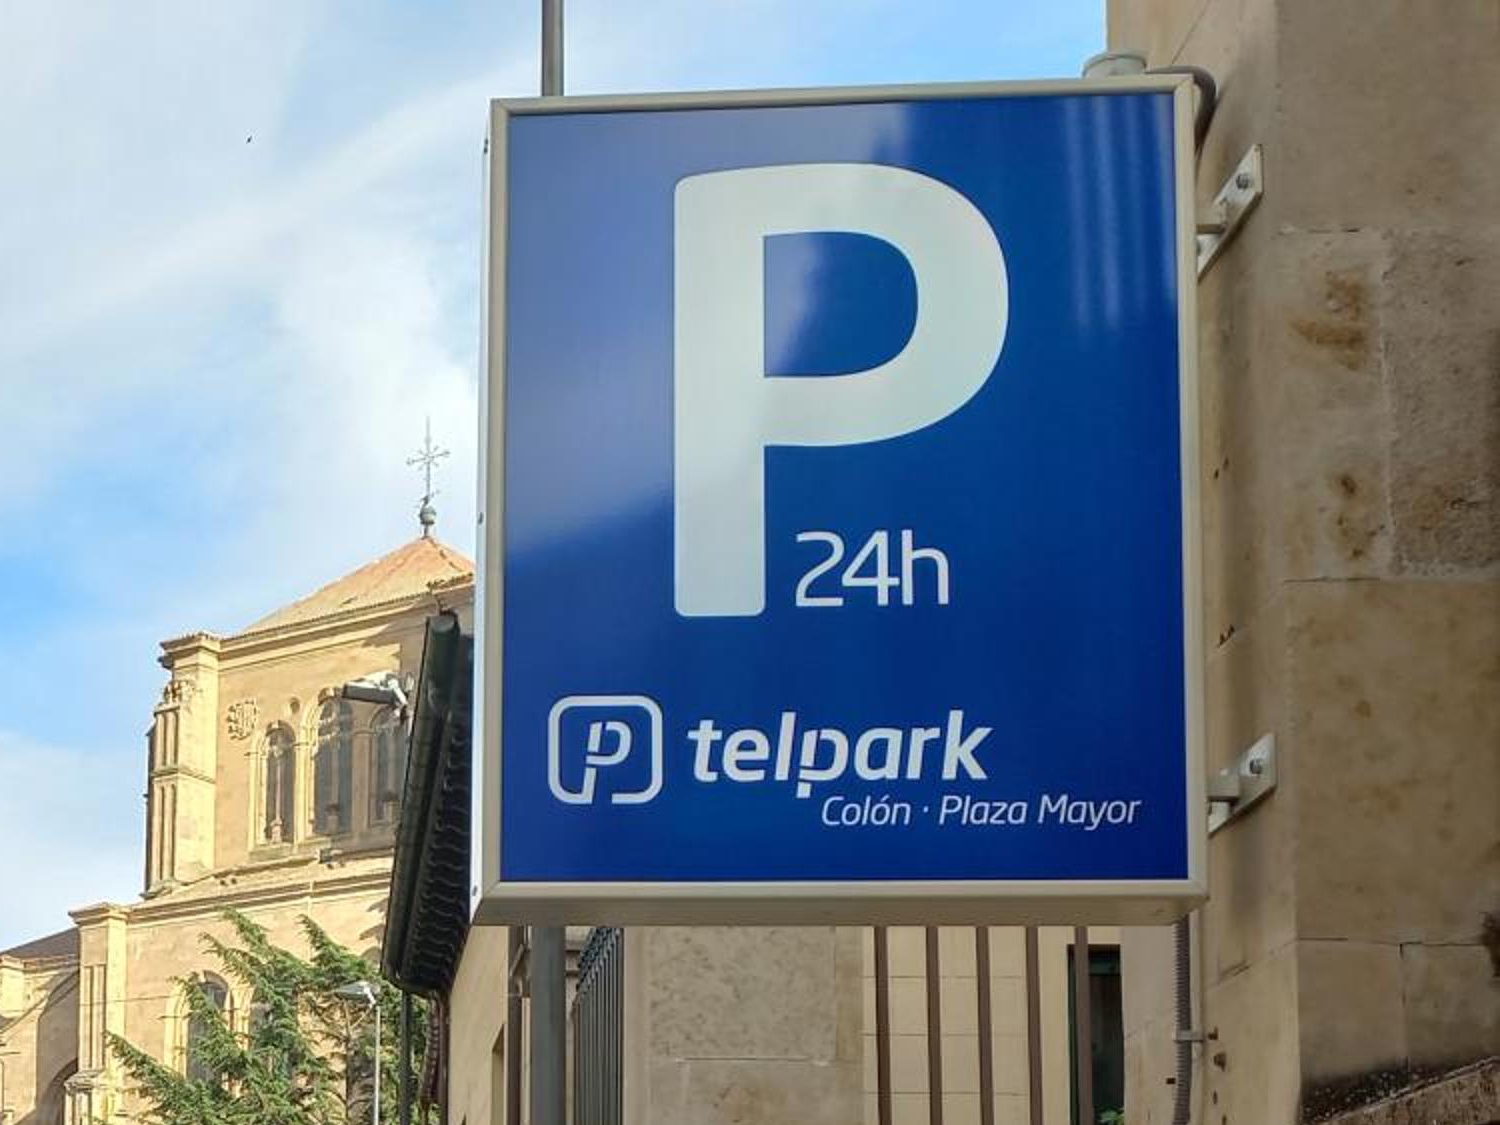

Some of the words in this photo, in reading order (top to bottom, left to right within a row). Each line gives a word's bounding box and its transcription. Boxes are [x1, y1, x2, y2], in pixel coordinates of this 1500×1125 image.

[674, 163, 1009, 617] P
[795, 530, 950, 607] 24h
[687, 710, 994, 799] telpark
[821, 795, 911, 827] Colón
[939, 795, 1028, 826] Plaza
[1037, 794, 1143, 832] Mayor
